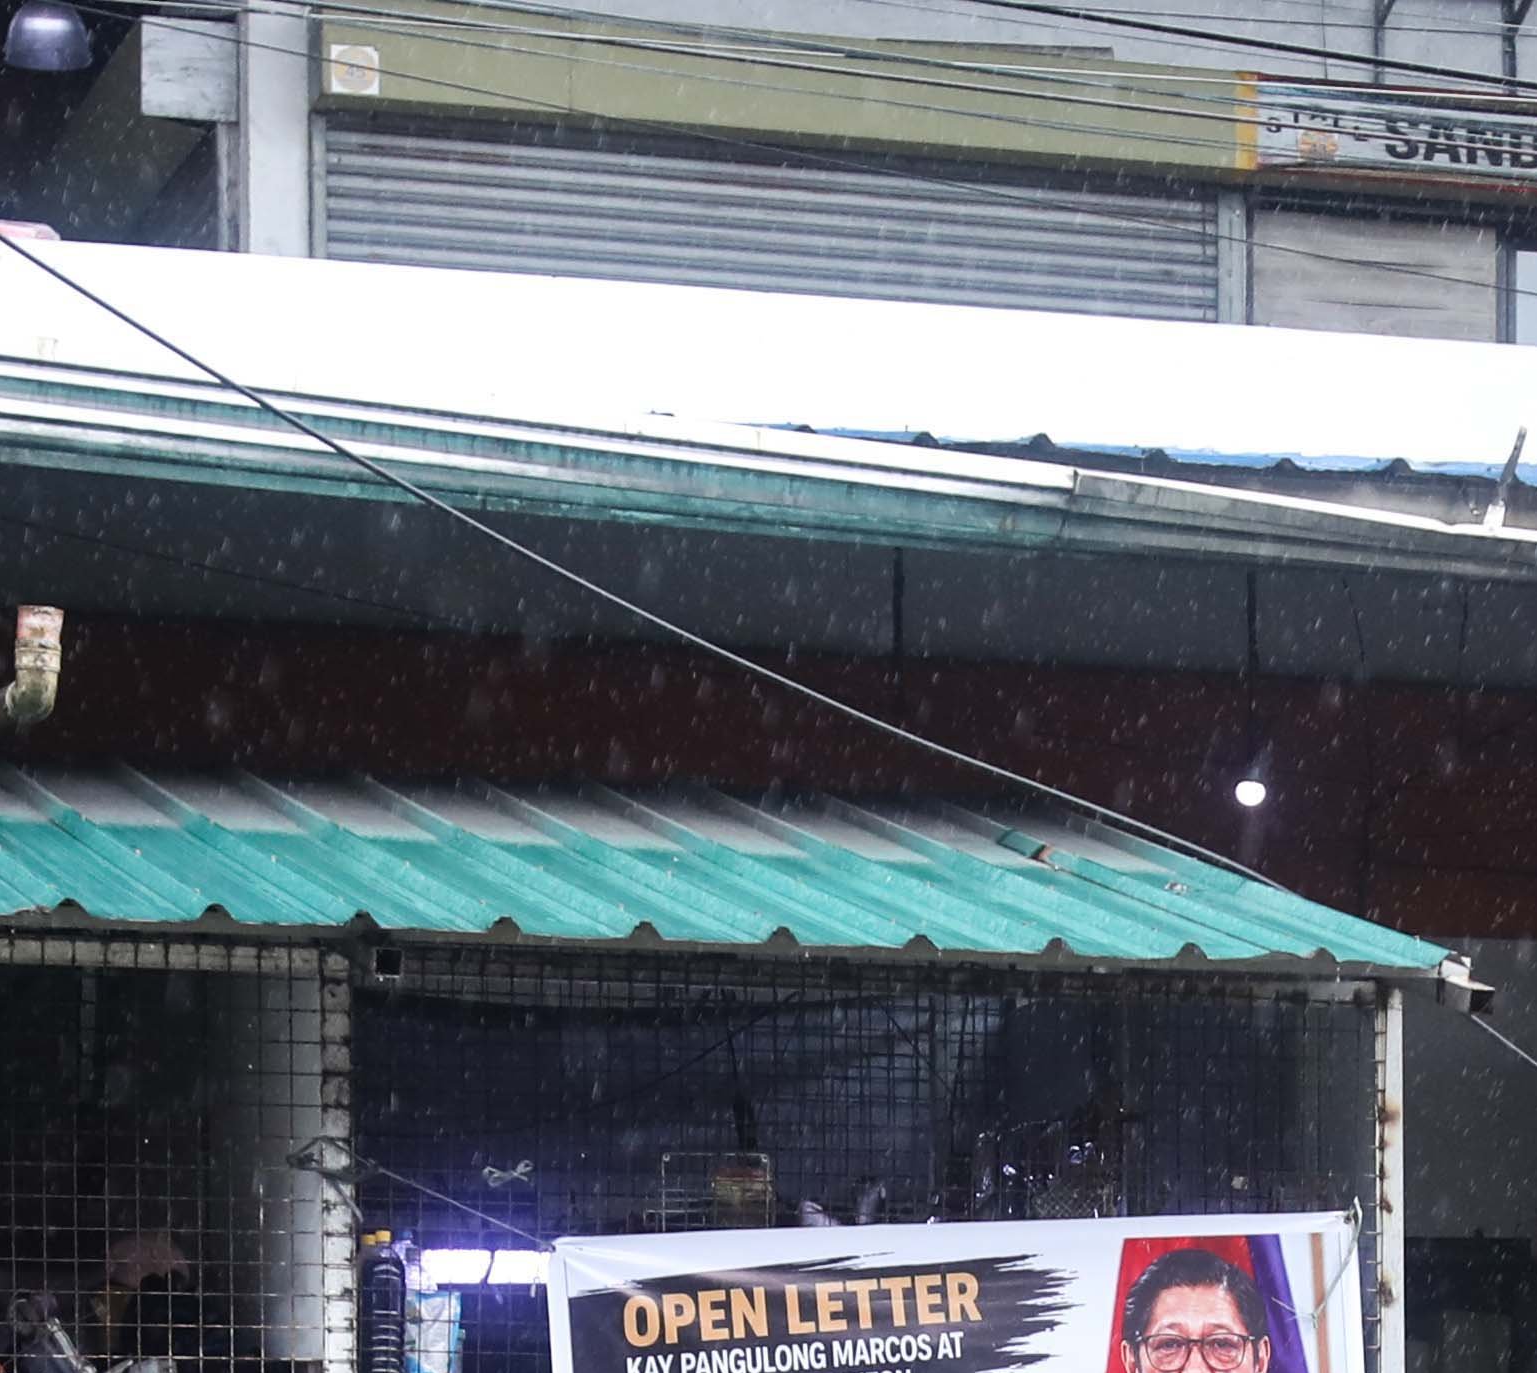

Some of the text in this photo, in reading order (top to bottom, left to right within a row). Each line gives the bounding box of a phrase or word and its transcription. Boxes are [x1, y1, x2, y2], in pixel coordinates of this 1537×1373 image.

[623, 1272, 983, 1348] OPEN LETTER
[833, 1335, 932, 1366] MARCOS
[937, 1331, 964, 1360] AT
